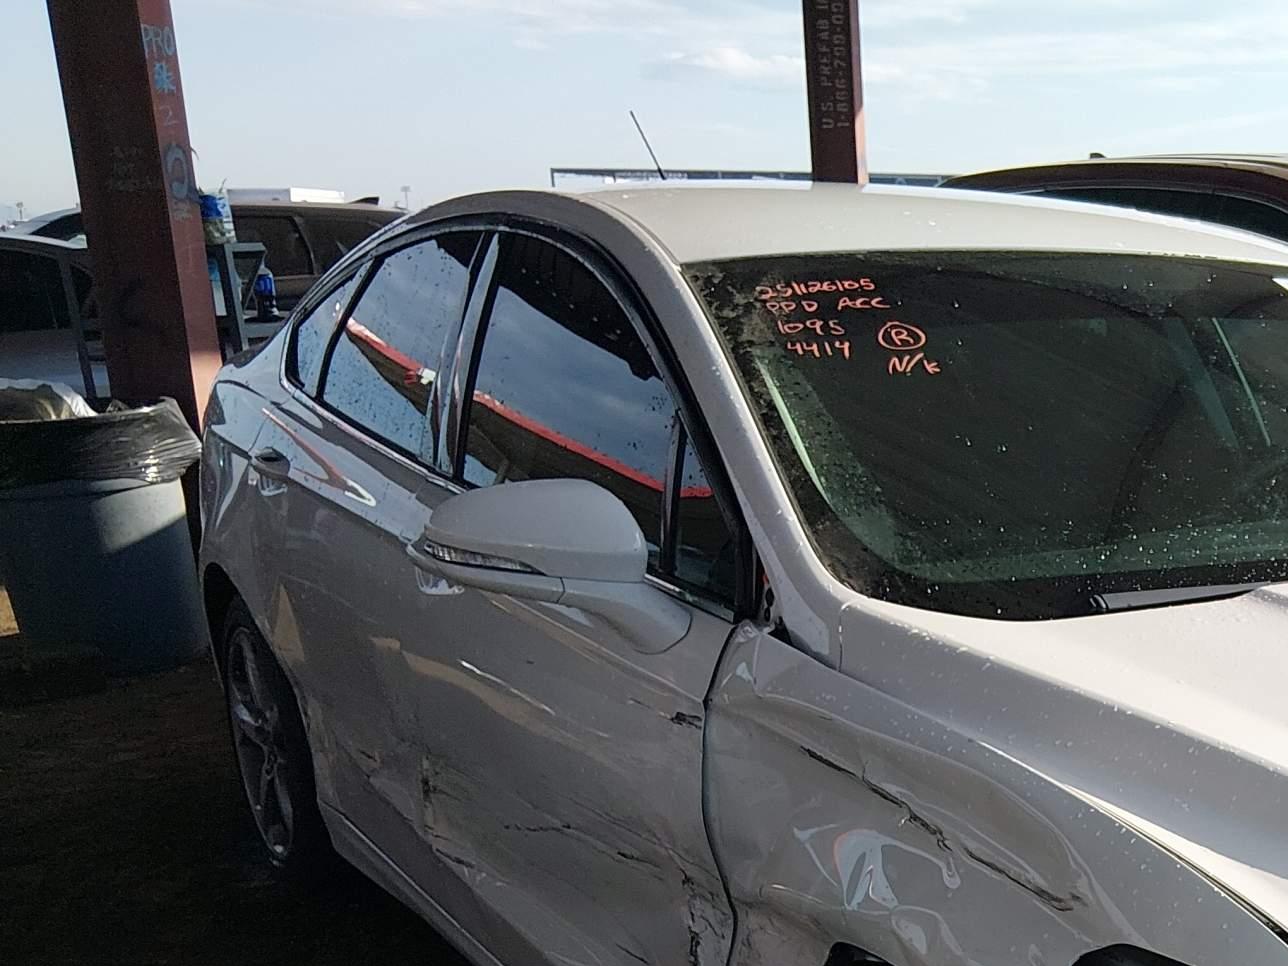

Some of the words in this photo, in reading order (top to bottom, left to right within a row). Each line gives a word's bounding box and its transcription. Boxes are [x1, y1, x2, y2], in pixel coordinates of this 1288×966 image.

[816, 19, 832, 86] PREFAB
[838, 297, 891, 310] ACC
[787, 340, 850, 360] 4414
